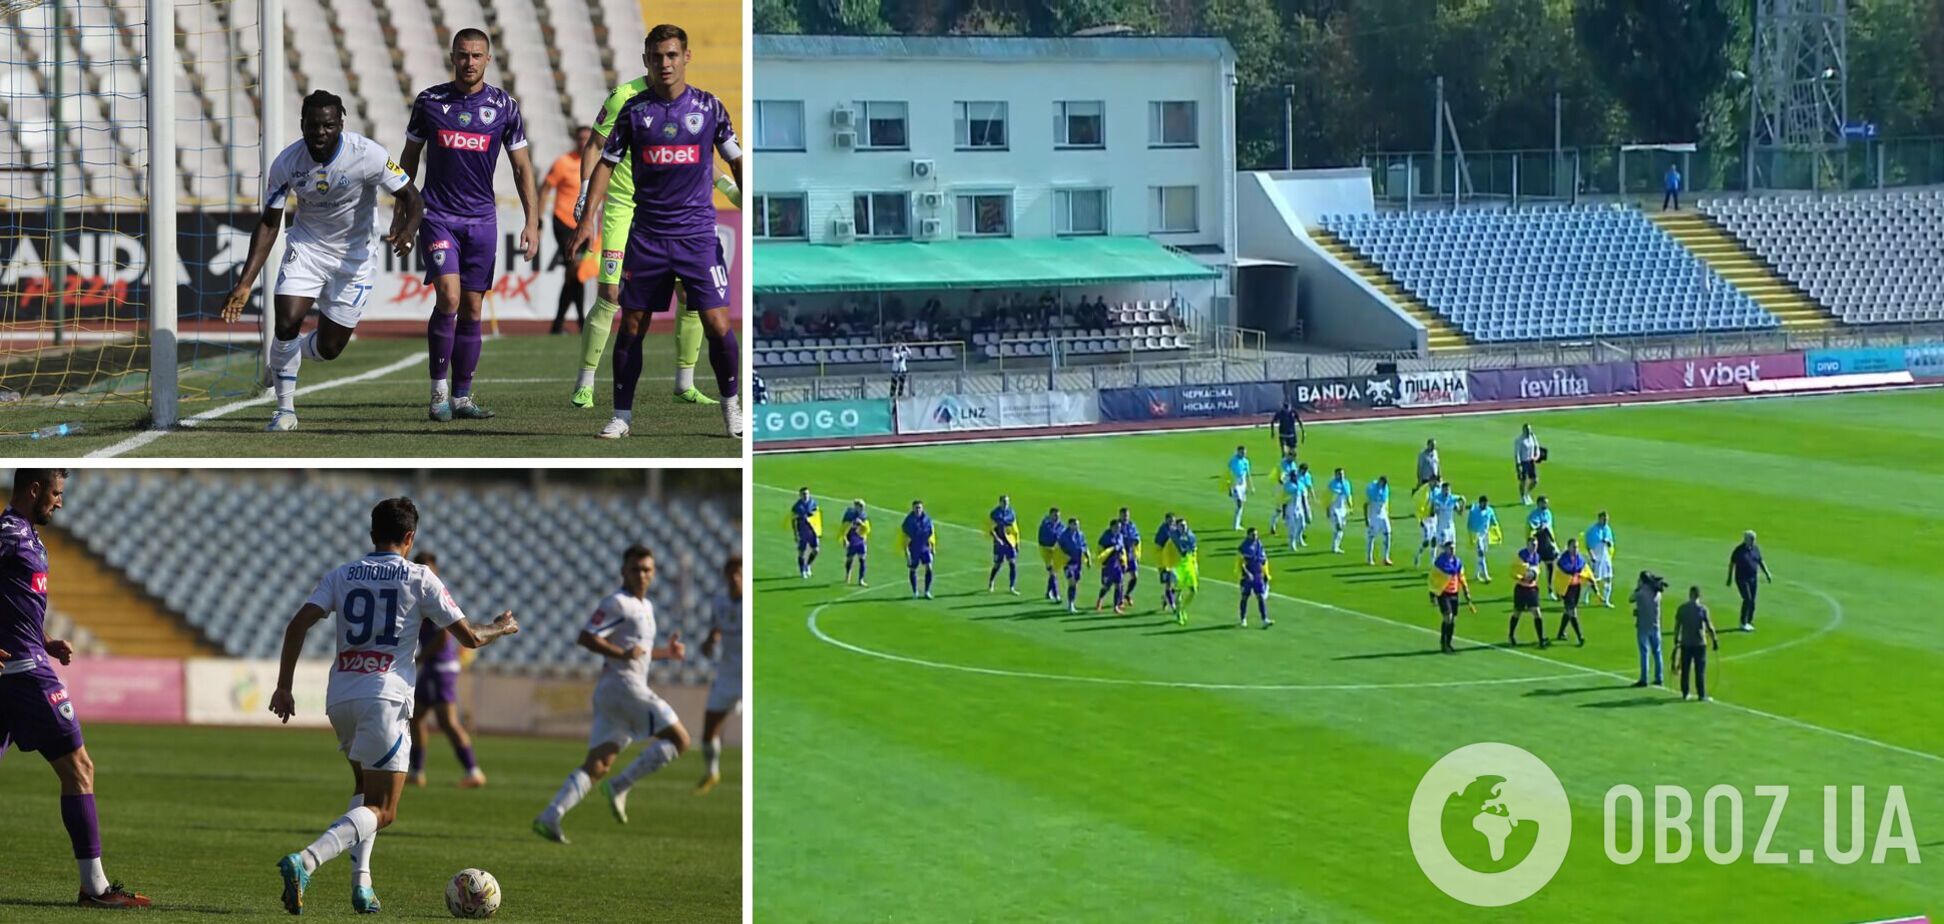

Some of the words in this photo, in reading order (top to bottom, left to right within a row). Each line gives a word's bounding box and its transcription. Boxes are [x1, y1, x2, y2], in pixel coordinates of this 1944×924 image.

[442, 133, 487, 150] vbet
[648, 146, 696, 163] vbet
[709, 265, 728, 288] 10
[1700, 359, 1760, 386] vbet
[1816, 361, 1840, 372] DIVO
[1405, 378, 1440, 393] ПІЦА
[1443, 377, 1465, 392] НА
[1520, 368, 1589, 398] tevitta
[1297, 383, 1361, 403] BANDA
[961, 407, 986, 419] LNZ
[346, 564, 409, 581] ВОЛОШИН
[343, 588, 399, 647] 91
[342, 653, 389, 671] vbet
